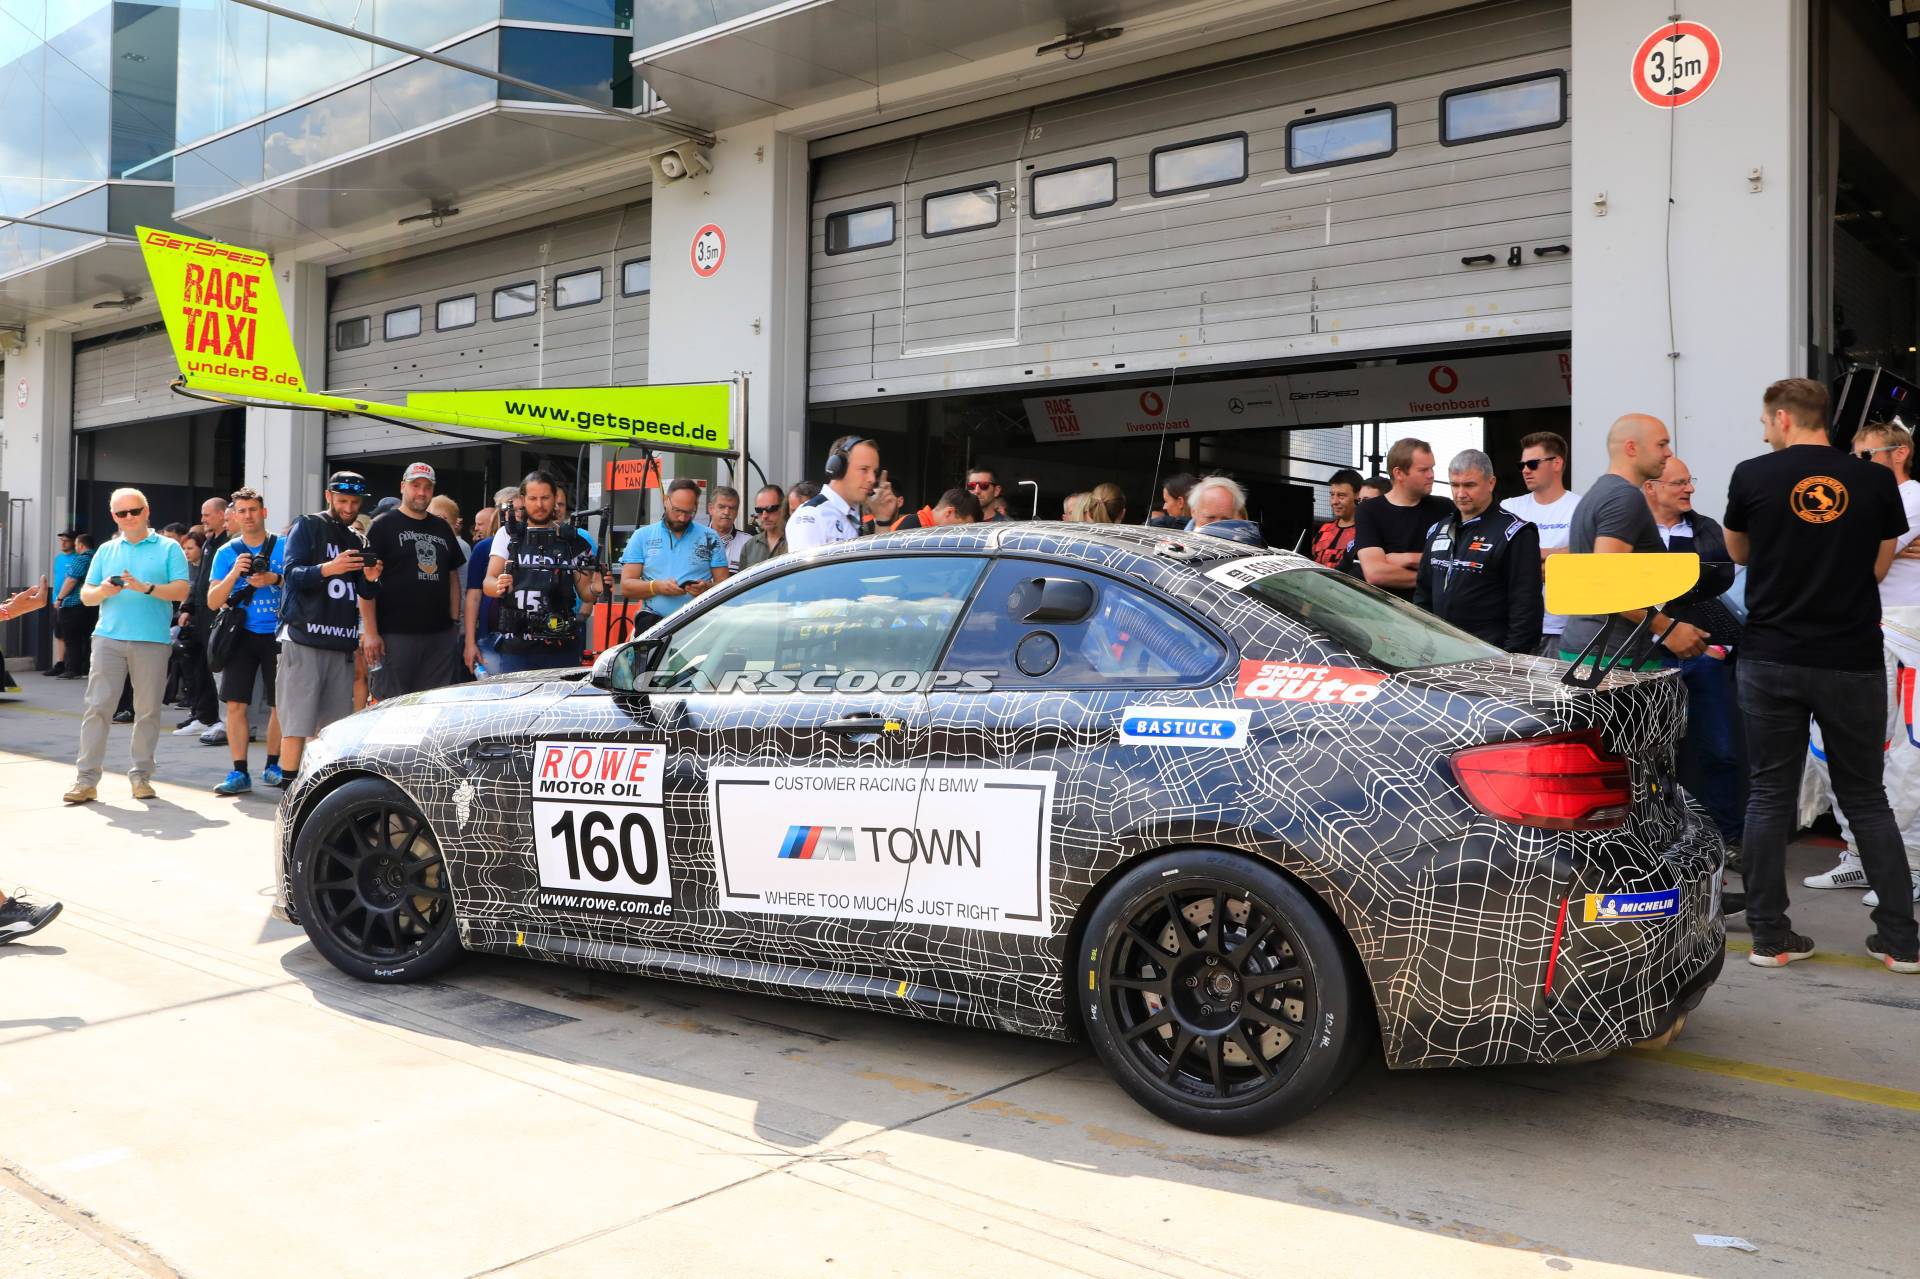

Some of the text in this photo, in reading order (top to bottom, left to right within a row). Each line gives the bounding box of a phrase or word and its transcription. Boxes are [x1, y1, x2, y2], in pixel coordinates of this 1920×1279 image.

[183, 263, 261, 314] RACE
[182, 306, 257, 361] TAXI
[187, 361, 299, 386] under8.de
[1044, 399, 1075, 415] RACE
[1409, 397, 1490, 413] liveonboard
[505, 400, 718, 442] www.getspeed.de
[1050, 415, 1081, 432] TAXI
[1126, 418, 1190, 433] liveonboard
[1257, 664, 1330, 681] sport
[1244, 677, 1381, 702] auto
[1136, 720, 1223, 736] BASTUCK
[541, 747, 653, 782] ROWE
[539, 780, 642, 797] MOTOR OIL
[774, 776, 979, 793] CUSTOMER RACING IN BMW
[551, 809, 659, 886] 160
[860, 826, 981, 868] TOWN
[1831, 869, 1865, 885] PUMA
[540, 893, 672, 917] www.rowe.com.de
[764, 890, 1000, 922] WHERE TOO MUCH IS JUST RIGHT
[1620, 899, 1674, 913] MICHELIN
